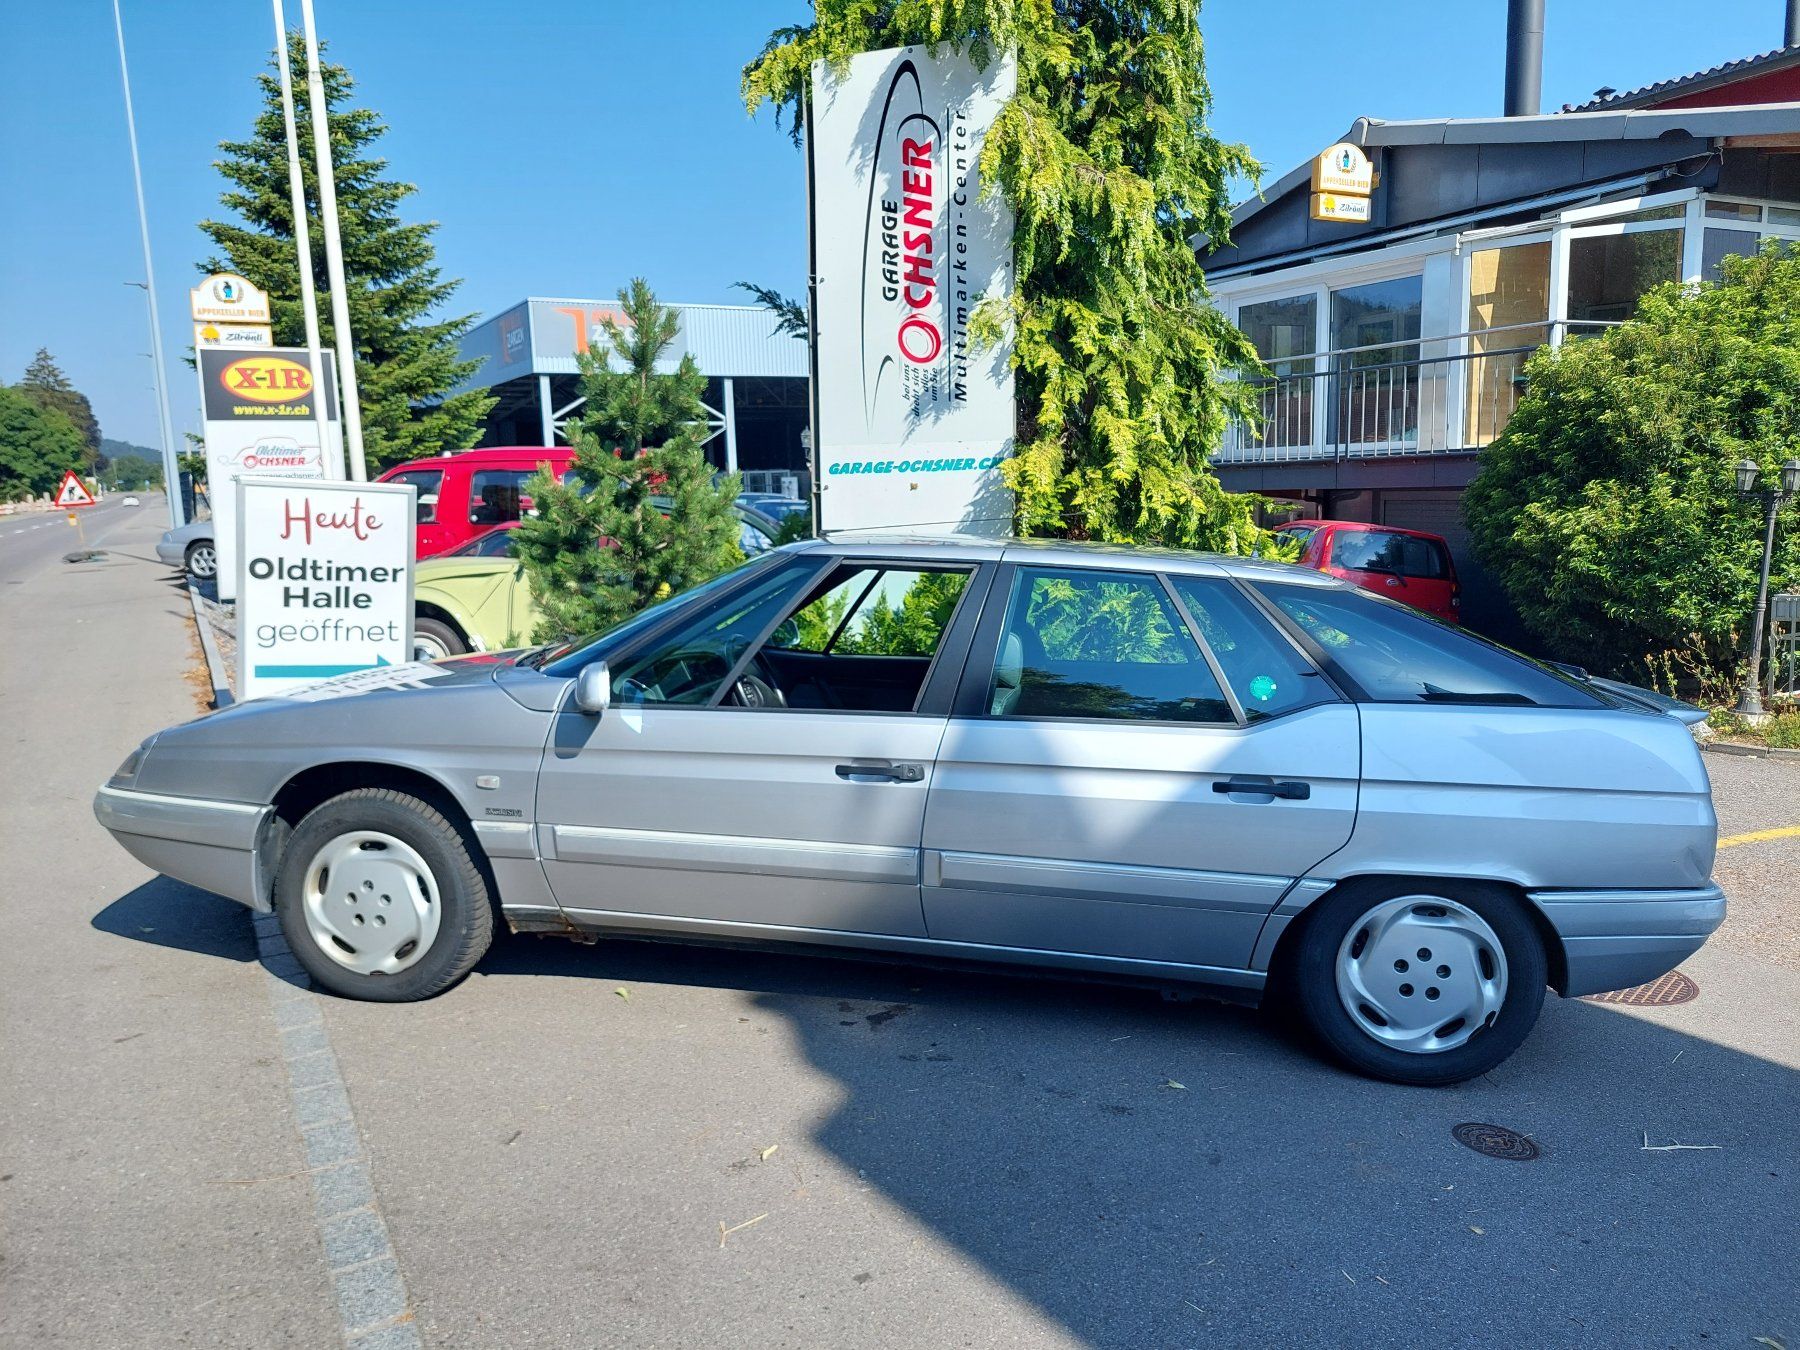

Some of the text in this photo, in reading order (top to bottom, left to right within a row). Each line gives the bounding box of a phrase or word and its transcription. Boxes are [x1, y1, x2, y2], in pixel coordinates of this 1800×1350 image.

[882, 199, 900, 301] GARAGE
[897, 137, 942, 363] OCHSNER
[953, 109, 968, 403] Multimarken-Center
[234, 367, 310, 390] X-1R
[911, 367, 920, 417] dreht sich
[920, 368, 929, 393] alles
[930, 367, 938, 402] um Sie
[902, 384, 911, 401] bei
[233, 404, 310, 416] www.x-1r.ch
[243, 455, 306, 469] OCHSNER
[280, 497, 383, 545] Heute
[249, 557, 404, 582] Oldtimer
[283, 586, 372, 609] Halle
[257, 618, 399, 648] geöffnet
